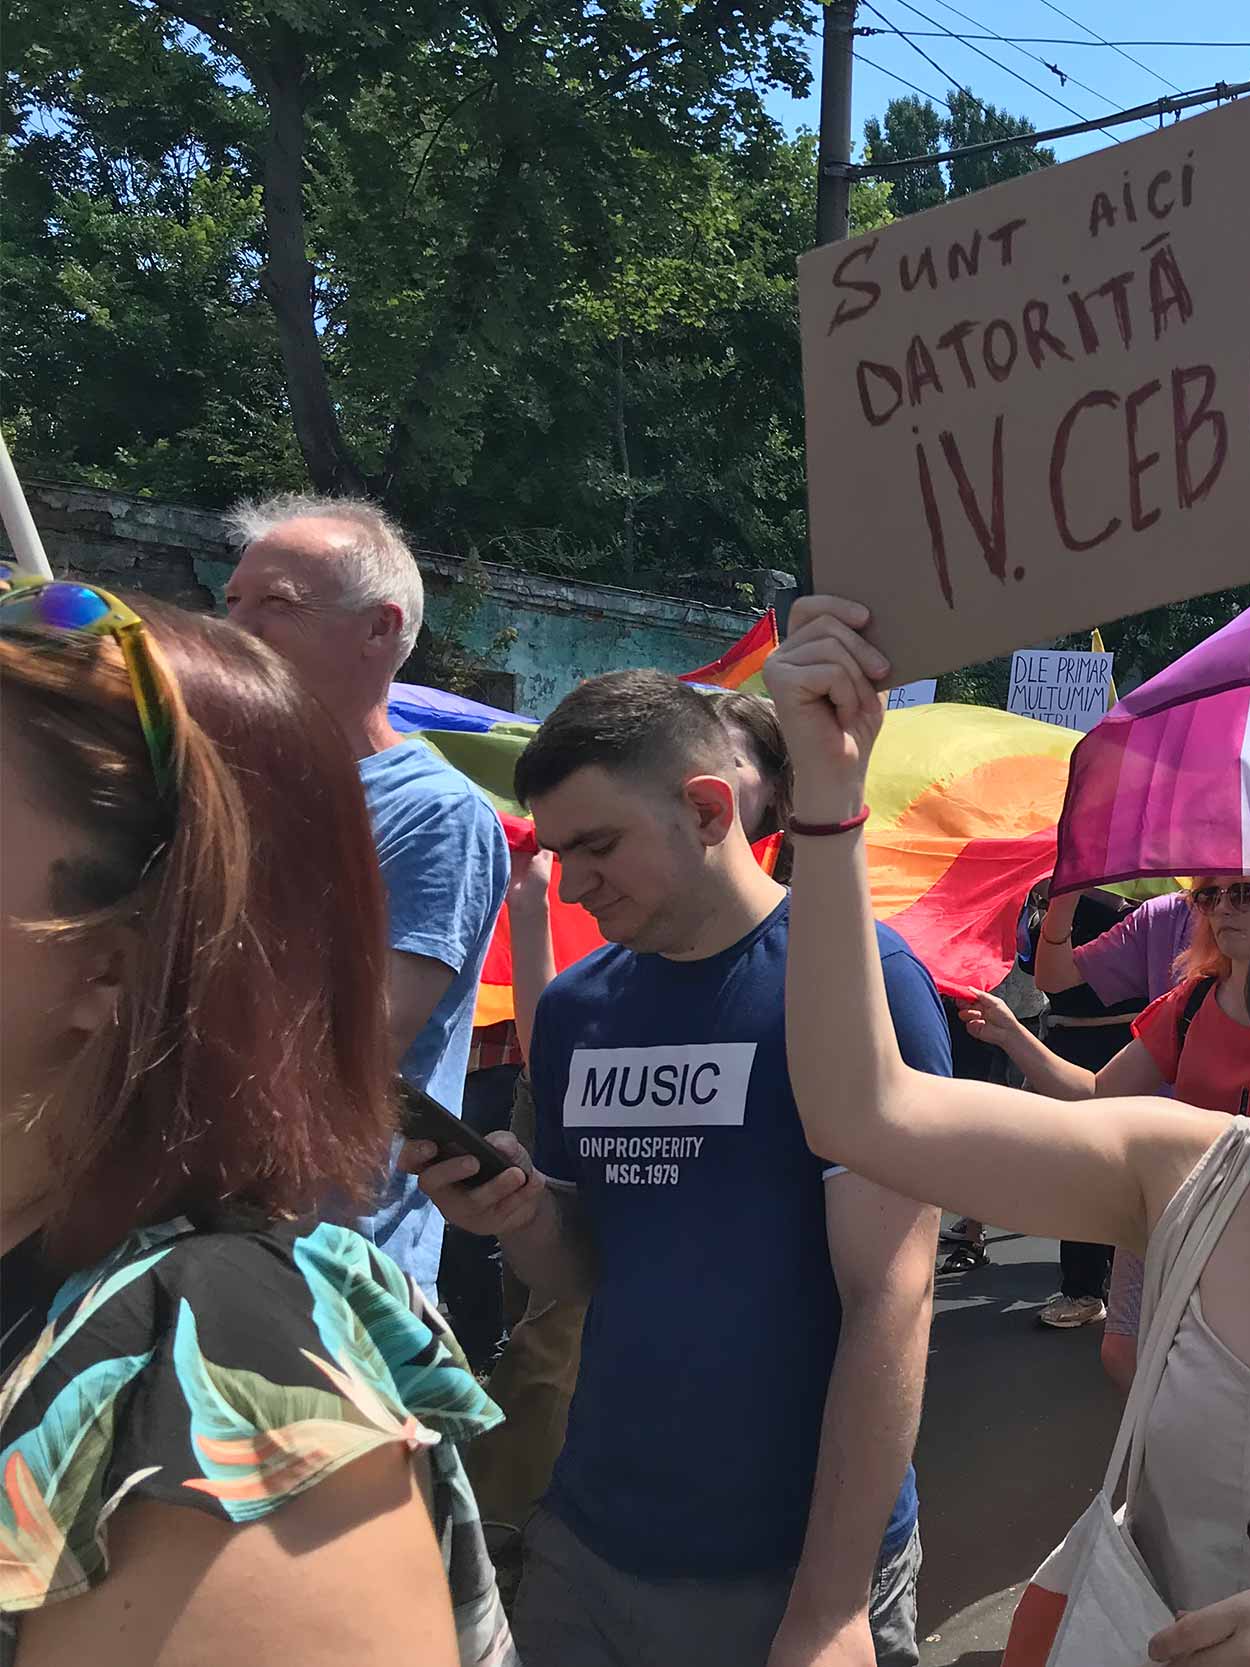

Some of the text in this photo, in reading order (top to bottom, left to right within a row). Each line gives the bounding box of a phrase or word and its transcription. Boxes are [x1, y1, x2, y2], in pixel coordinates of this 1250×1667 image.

[1014, 655, 1108, 684] DLE PRIMAR
[580, 1062, 721, 1107] MUSIC
[605, 1163, 679, 1185] MSC.1979
